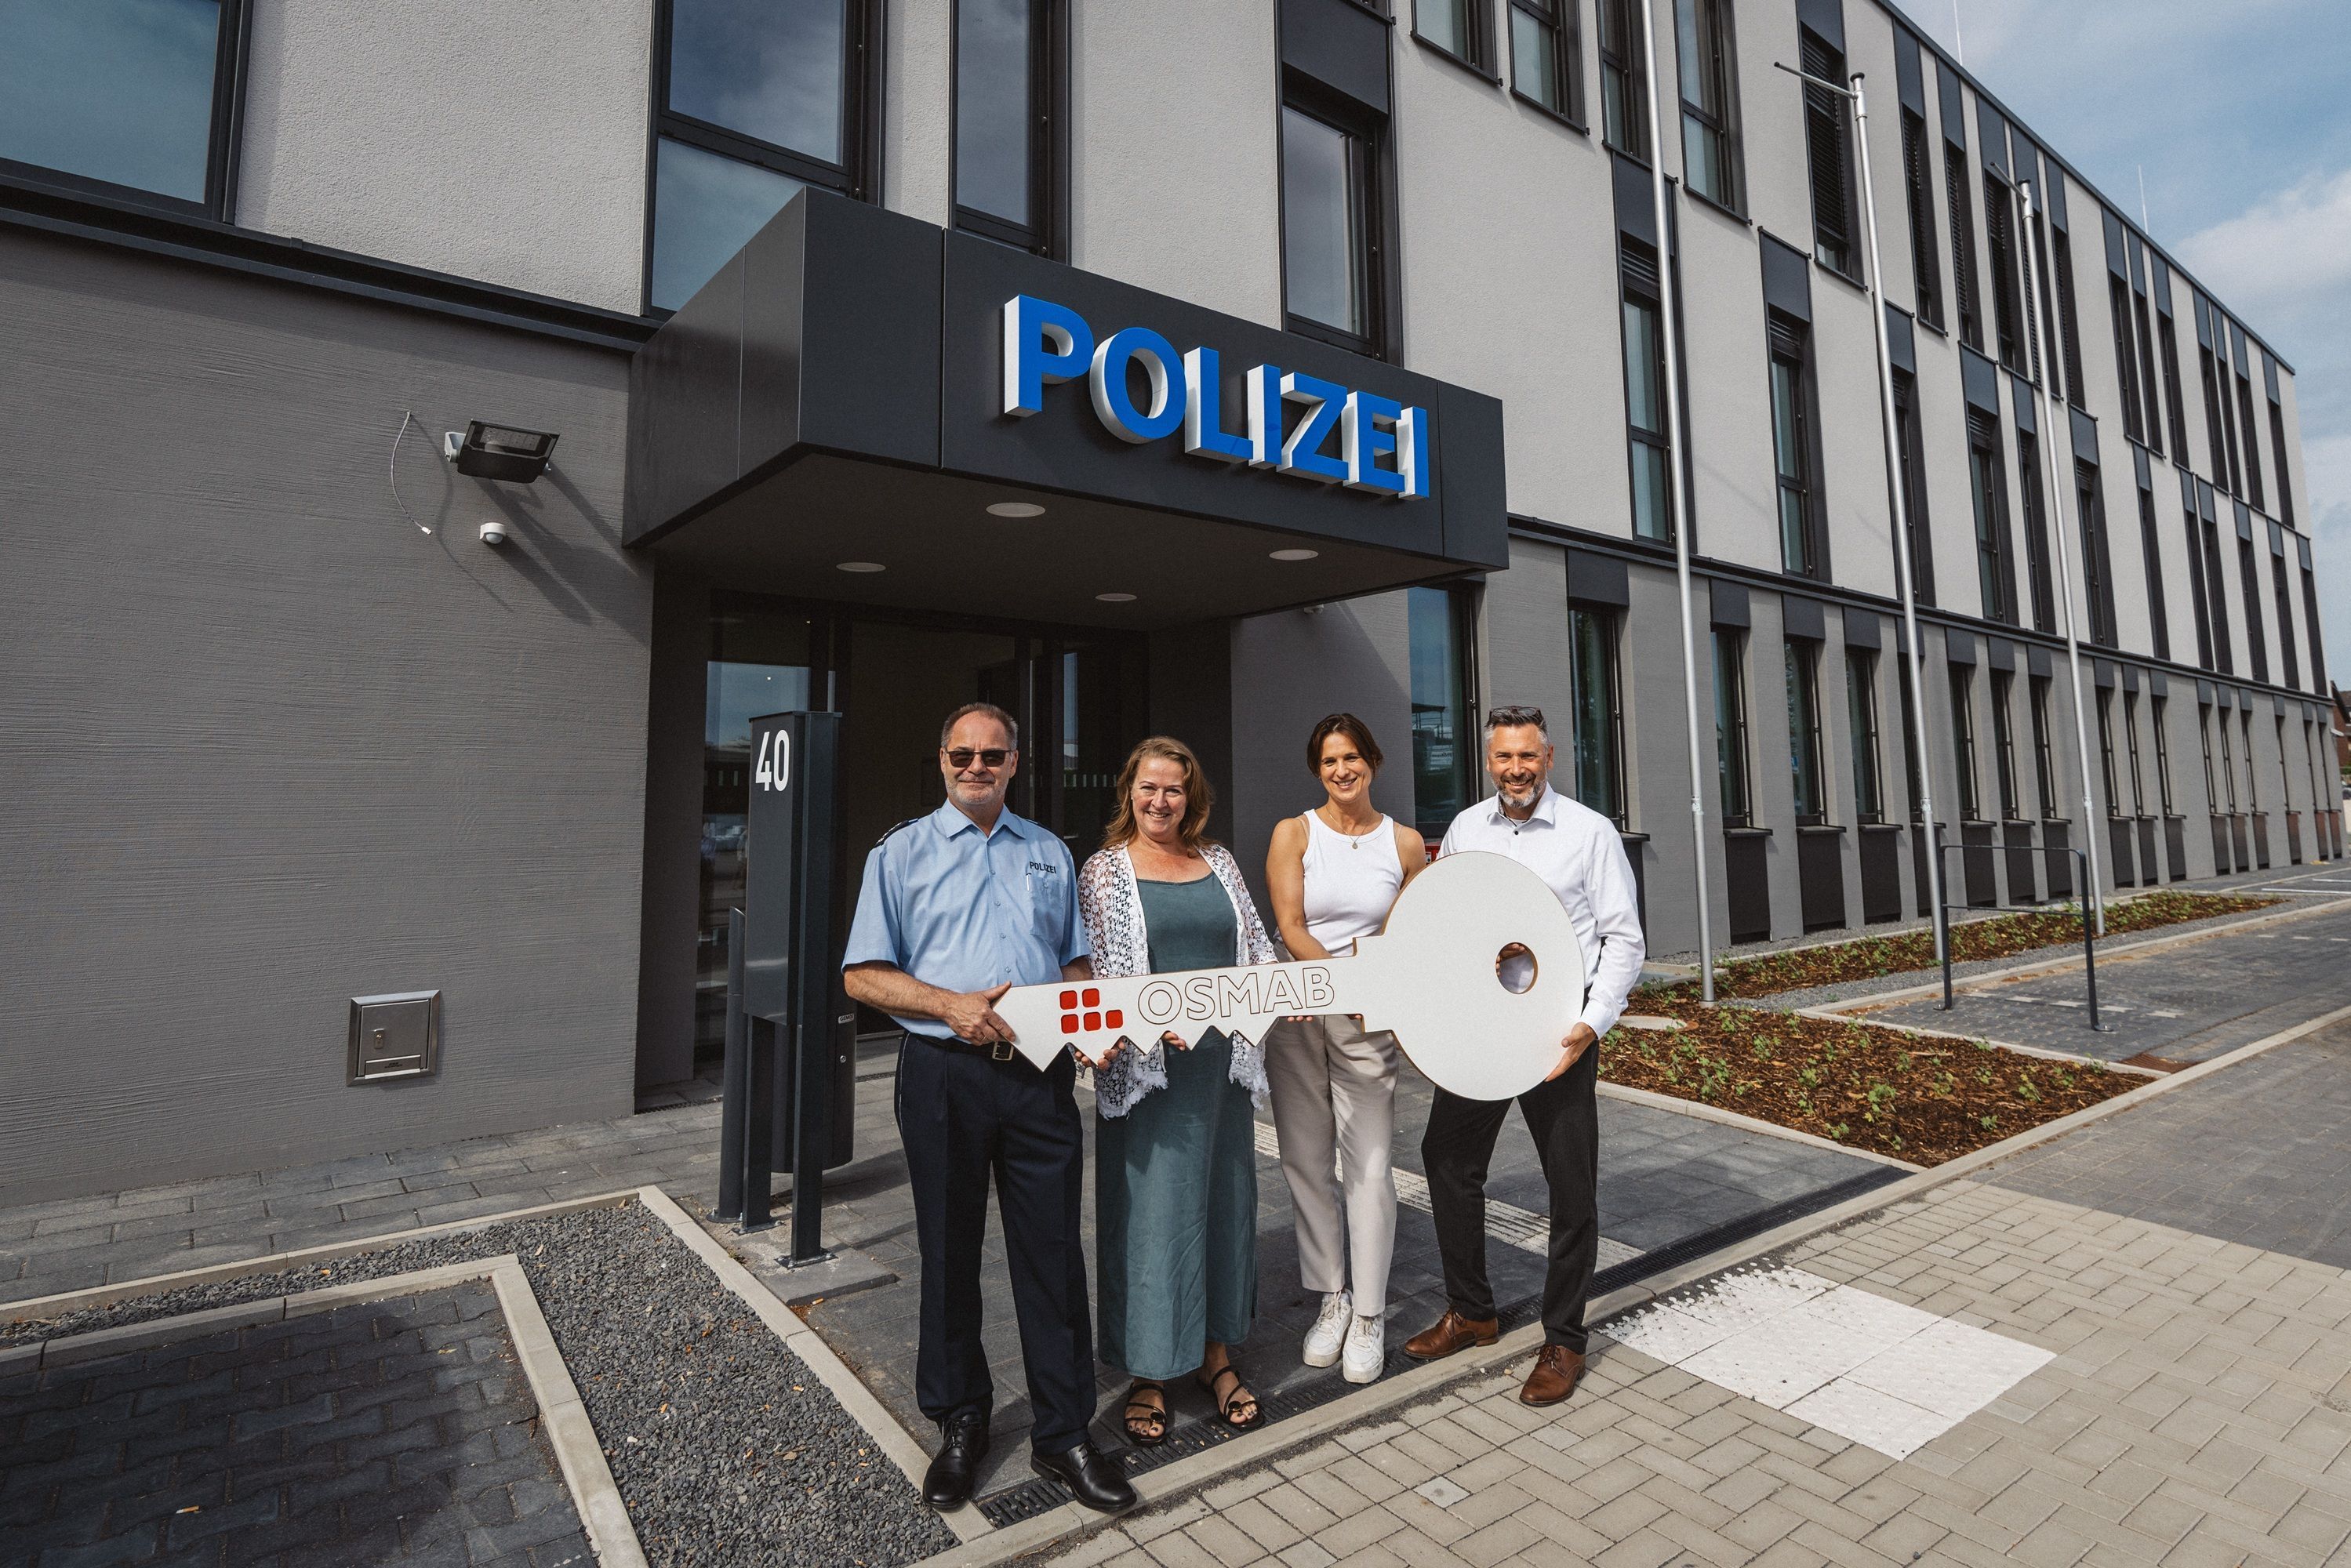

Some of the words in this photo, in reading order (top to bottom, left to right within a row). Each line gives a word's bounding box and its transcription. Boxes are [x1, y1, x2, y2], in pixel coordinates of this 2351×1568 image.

[1004, 294, 1430, 501] POLIZEI
[755, 729, 790, 792] 40
[1029, 861, 1057, 874] POLIZEI
[1138, 966, 1335, 1025] OSMAB
